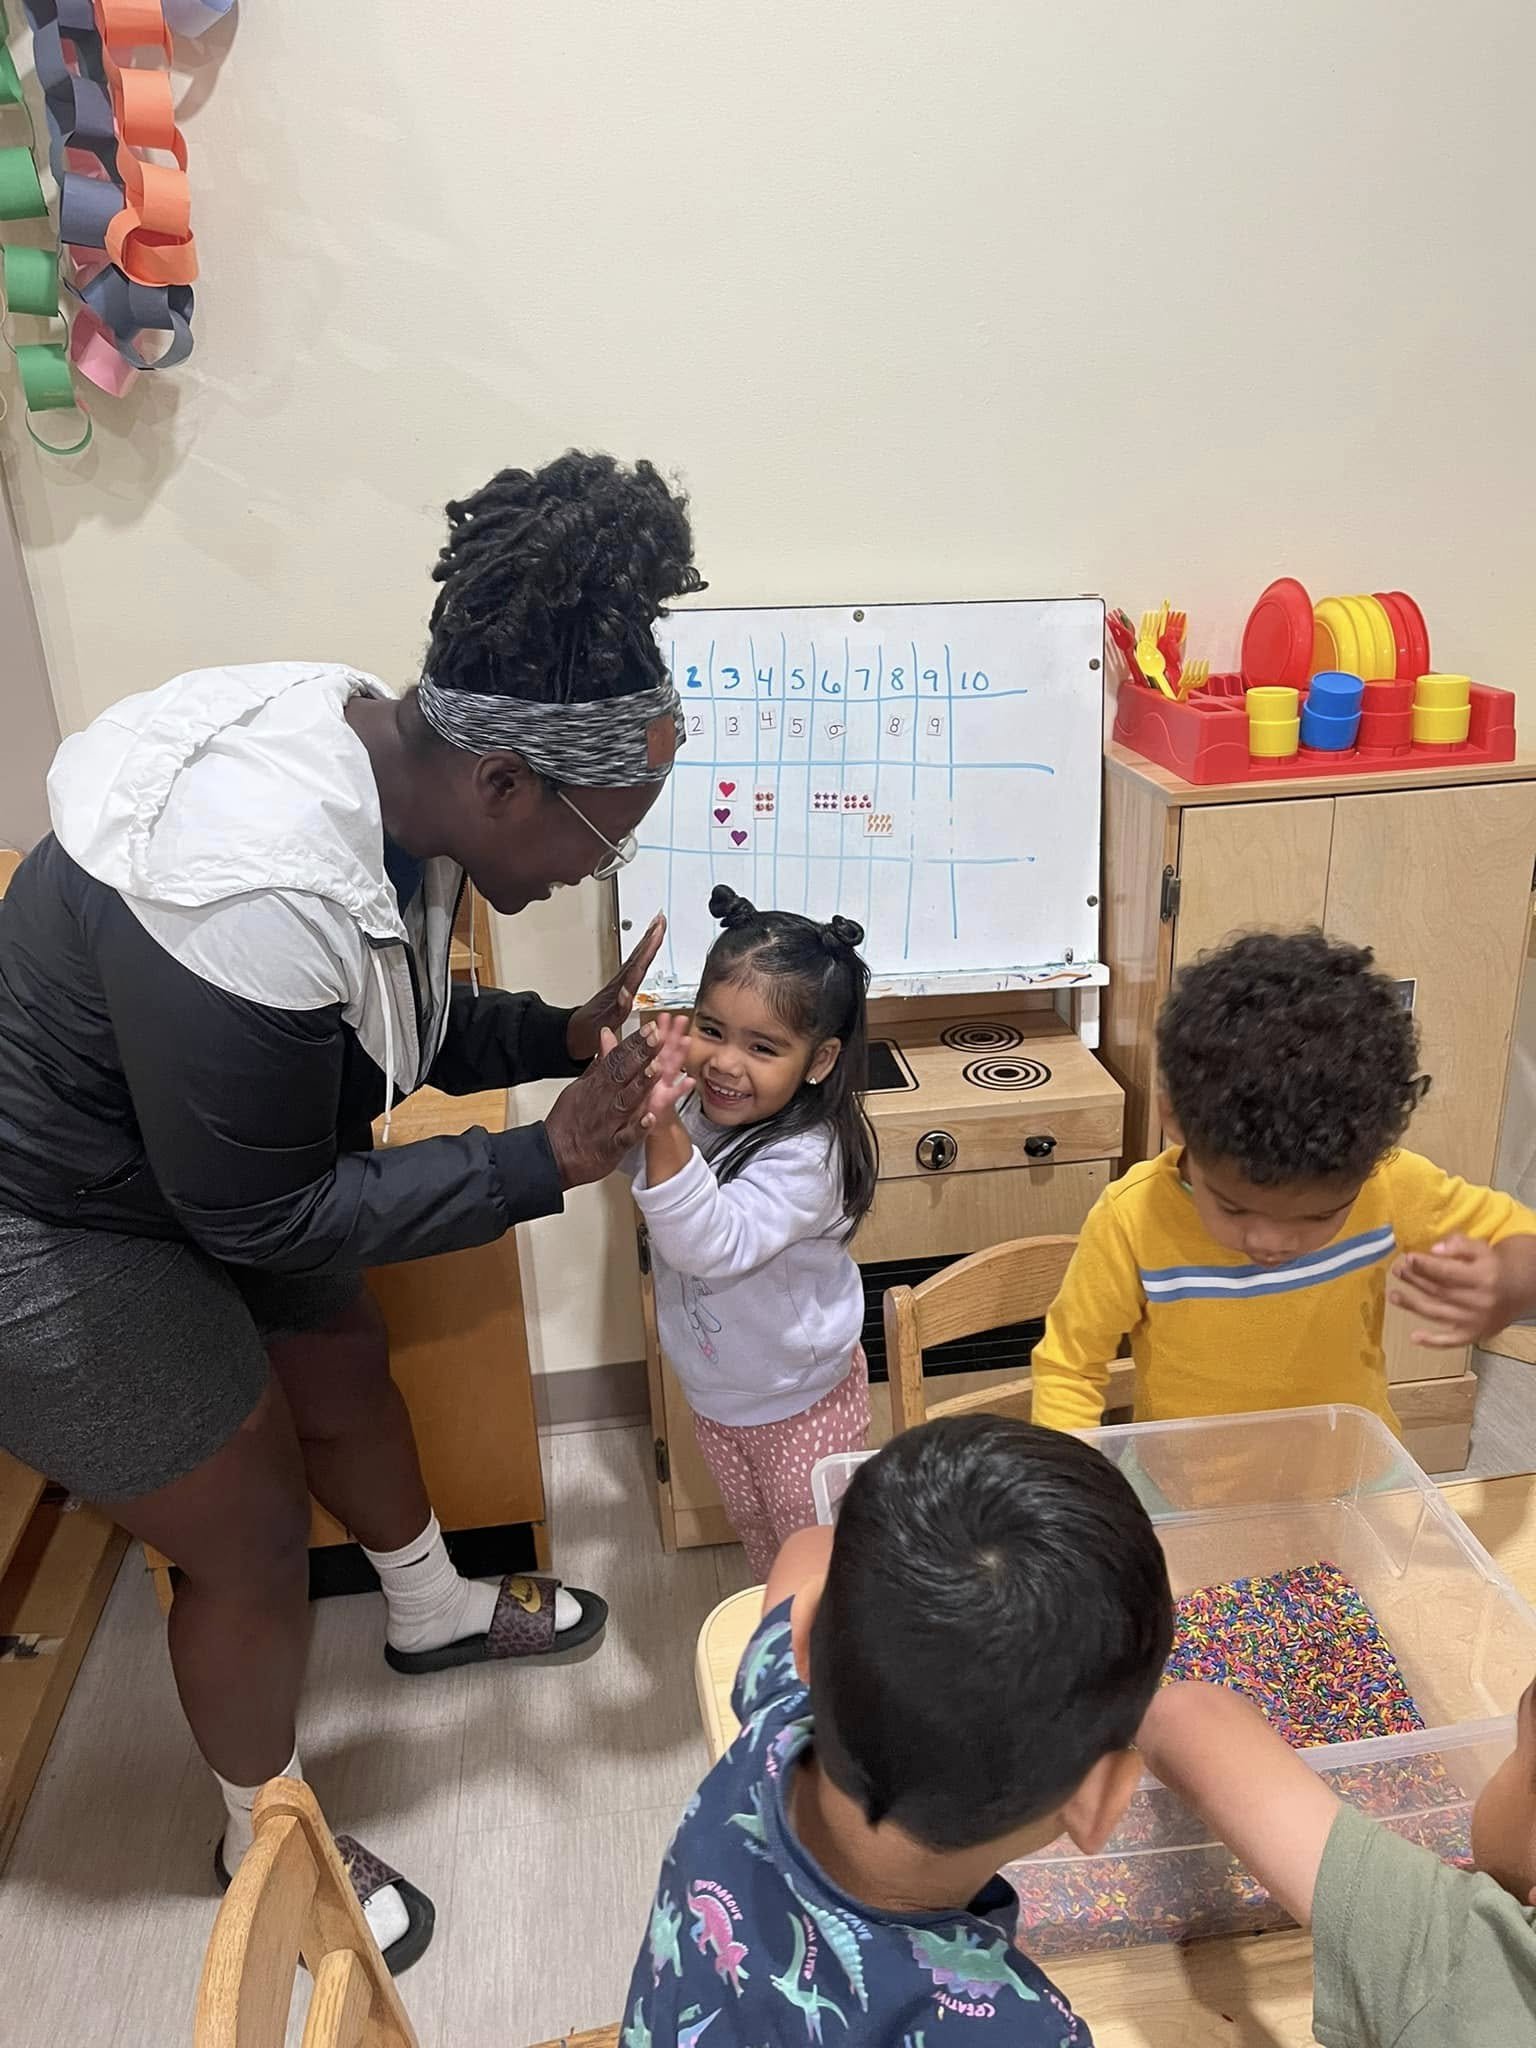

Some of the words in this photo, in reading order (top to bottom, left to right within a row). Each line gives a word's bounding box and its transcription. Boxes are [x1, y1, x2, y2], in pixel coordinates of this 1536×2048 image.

[687, 666, 702, 688] 2
[721, 668, 740, 689] 3
[758, 667, 772, 696] 4
[791, 669, 805, 690] 5
[821, 670, 841, 694] 6
[855, 669, 870, 691] 7
[891, 667, 904, 690] 8
[923, 670, 938, 691] 9
[961, 671, 989, 691] 10
[692, 715, 702, 732] 2
[729, 716, 739, 732] 3
[761, 711, 772, 727] 4
[792, 718, 803, 734] 5
[889, 717, 900, 733] 8
[931, 718, 940, 733] 9
